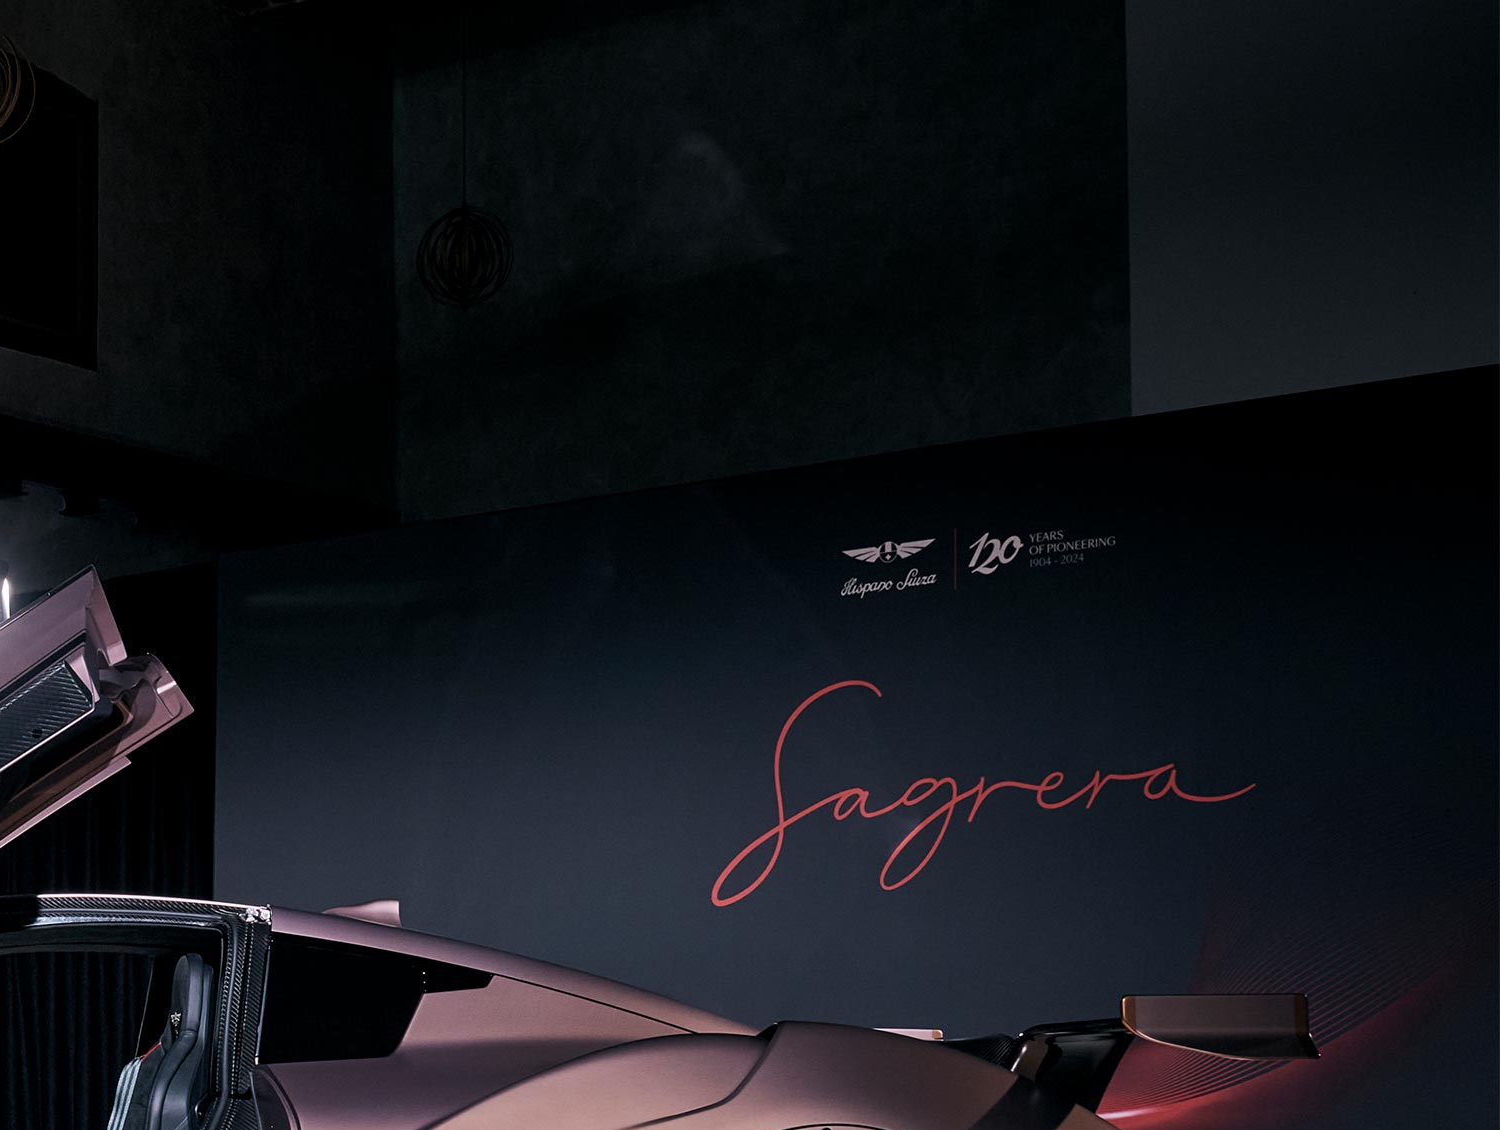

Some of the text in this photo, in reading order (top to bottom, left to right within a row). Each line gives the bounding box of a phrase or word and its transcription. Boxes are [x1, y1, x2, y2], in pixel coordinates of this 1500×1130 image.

[1029, 530, 1064, 544] YEARS
[1029, 535, 1117, 556] OF PIONEERING
[968, 531, 1025, 575] 120
[1029, 555, 1052, 568] 1904
[1061, 553, 1085, 565] 2024
[840, 568, 938, 599] Hispano Suiza
[711, 680, 1257, 907] Sagrera
